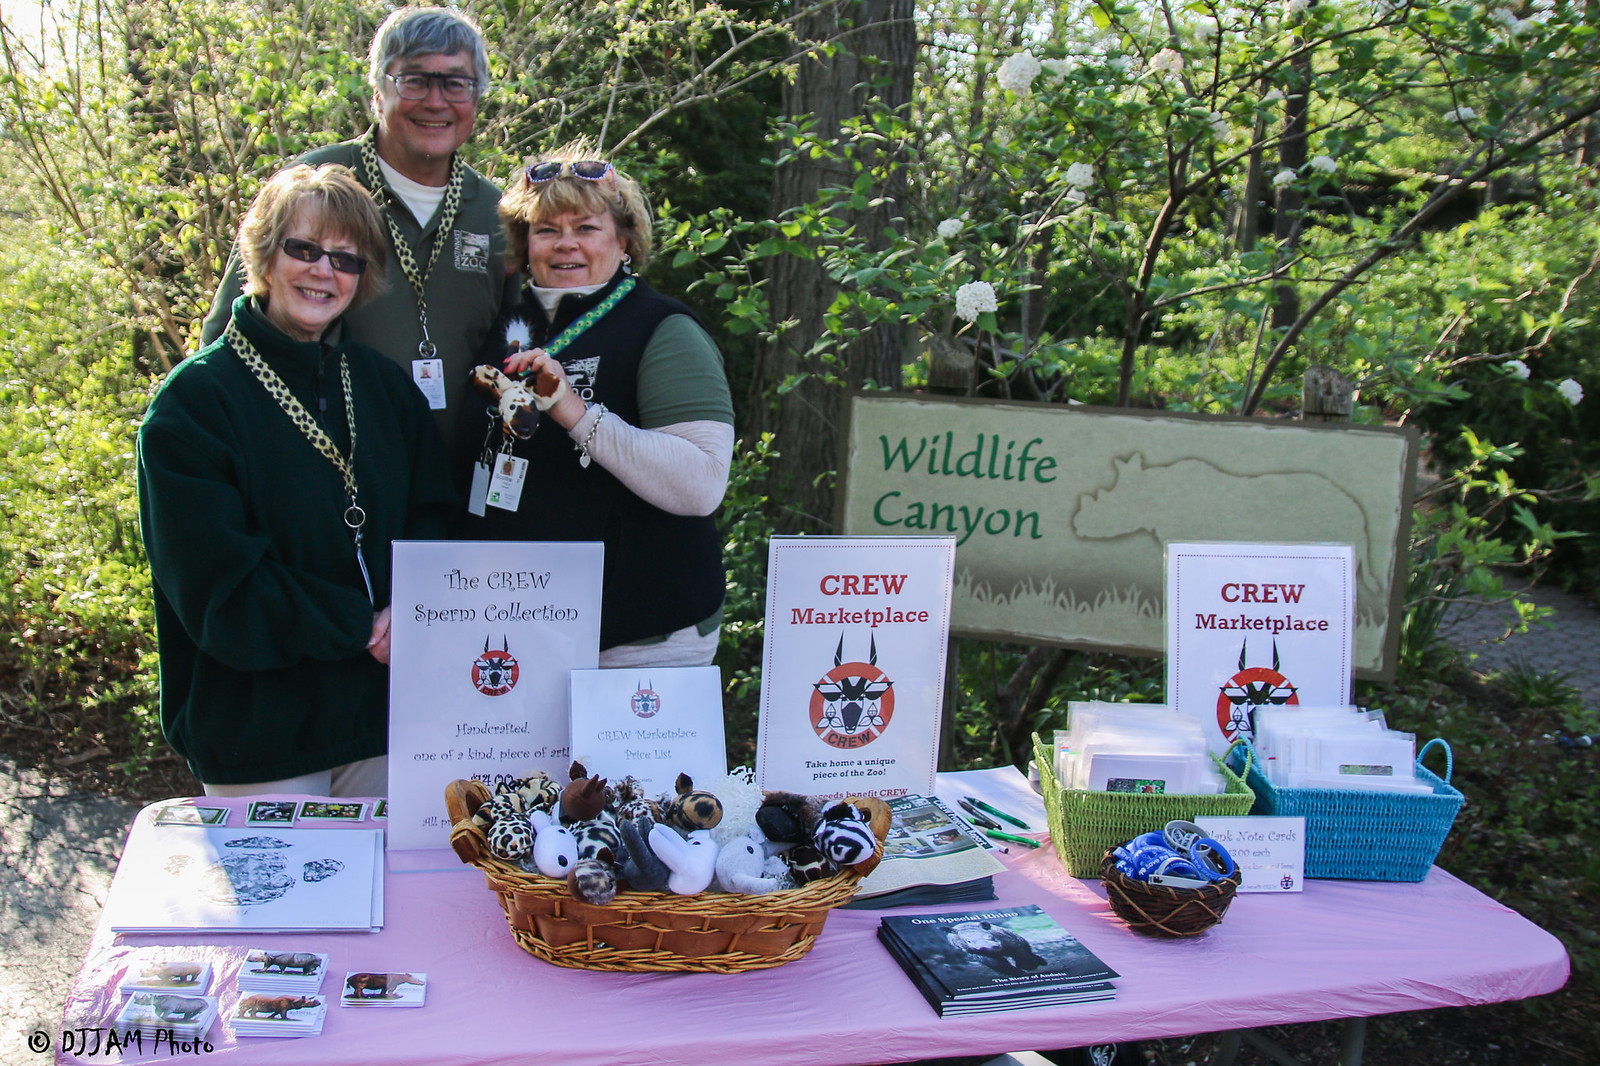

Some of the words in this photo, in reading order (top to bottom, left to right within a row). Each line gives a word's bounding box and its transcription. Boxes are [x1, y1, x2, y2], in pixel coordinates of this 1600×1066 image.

[879, 430, 1059, 483] Wildlife
[873, 490, 1043, 548] Canyon
[444, 568, 480, 590] The
[487, 571, 551, 592] CREW
[820, 574, 908, 595] CREW
[1221, 583, 1305, 603] CREW
[414, 603, 477, 626] Sperm
[484, 601, 579, 623] Collection
[790, 607, 929, 628] Marketplace
[1195, 613, 1329, 634] Marketplace
[597, 730, 632, 742] CREW
[634, 727, 697, 741] Marketplace
[827, 731, 872, 749] CREW
[413, 752, 437, 762] one
[440, 749, 454, 761] of
[457, 752, 464, 761] a
[500, 748, 530, 762] piece
[534, 747, 548, 759] of
[624, 748, 651, 761] Price
[654, 749, 672, 760] List
[805, 760, 828, 769] Take
[829, 759, 855, 768] home
[864, 757, 896, 767] unique
[812, 770, 838, 781] piece
[840, 769, 850, 778] of
[850, 769, 865, 777] the
[866, 768, 887, 777] Zoo!
[846, 789, 878, 798] benefit
[879, 788, 909, 797] CREW
[1209, 829, 1233, 842] lank
[1236, 831, 1265, 842] Note
[1268, 829, 1297, 842] Cards
[1252, 847, 1271, 858] each
[937, 914, 982, 924] Special
[982, 911, 1020, 920] Rhino
